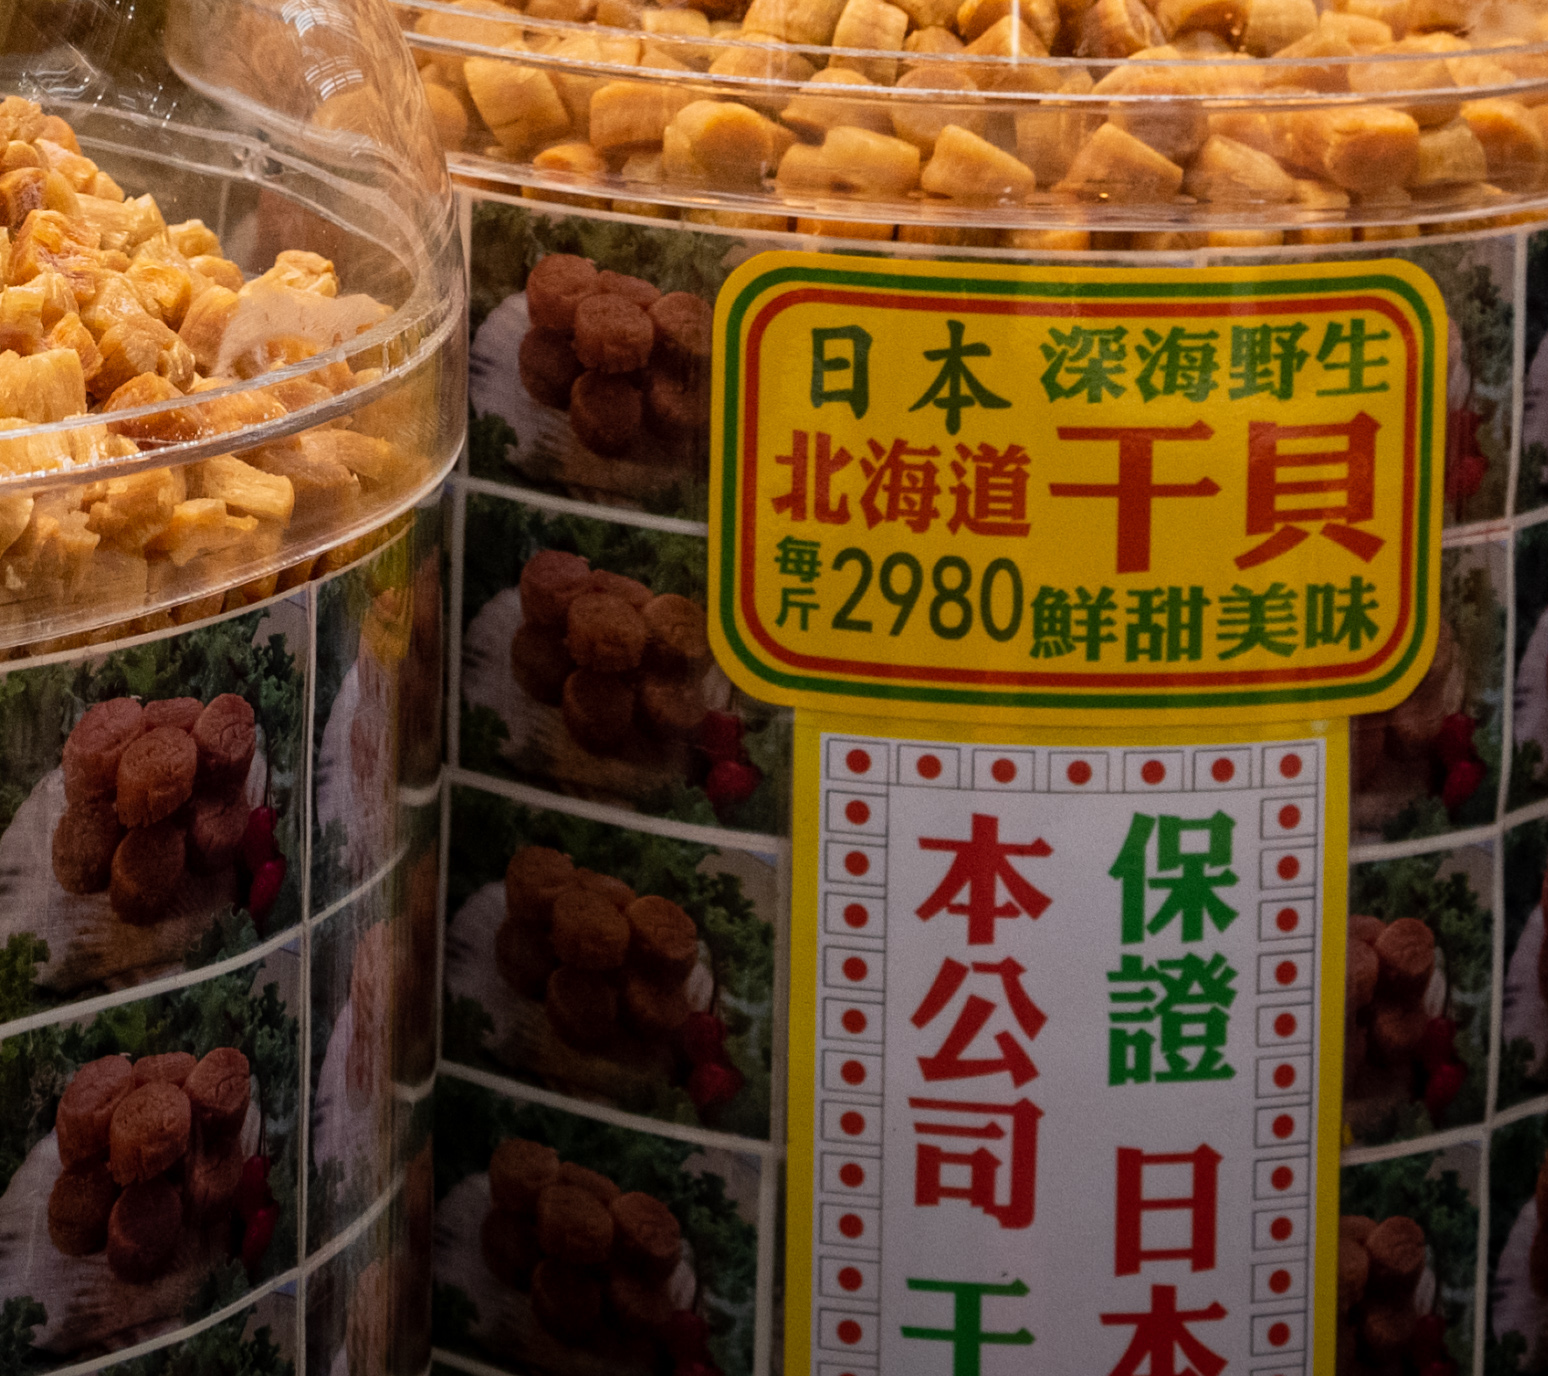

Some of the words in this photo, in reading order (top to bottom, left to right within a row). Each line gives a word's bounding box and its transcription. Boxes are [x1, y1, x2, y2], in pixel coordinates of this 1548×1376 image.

[810, 319, 1013, 435] 日本
[1038, 317, 1392, 404] 深海野生
[771, 429, 1032, 538] 北海道
[1048, 411, 1387, 574] 干貝
[831, 547, 1025, 641] 2980
[1029, 575, 1380, 662] 鮮甜美味
[908, 813, 1053, 1230] 本公司
[1106, 810, 1240, 1087] 保證
